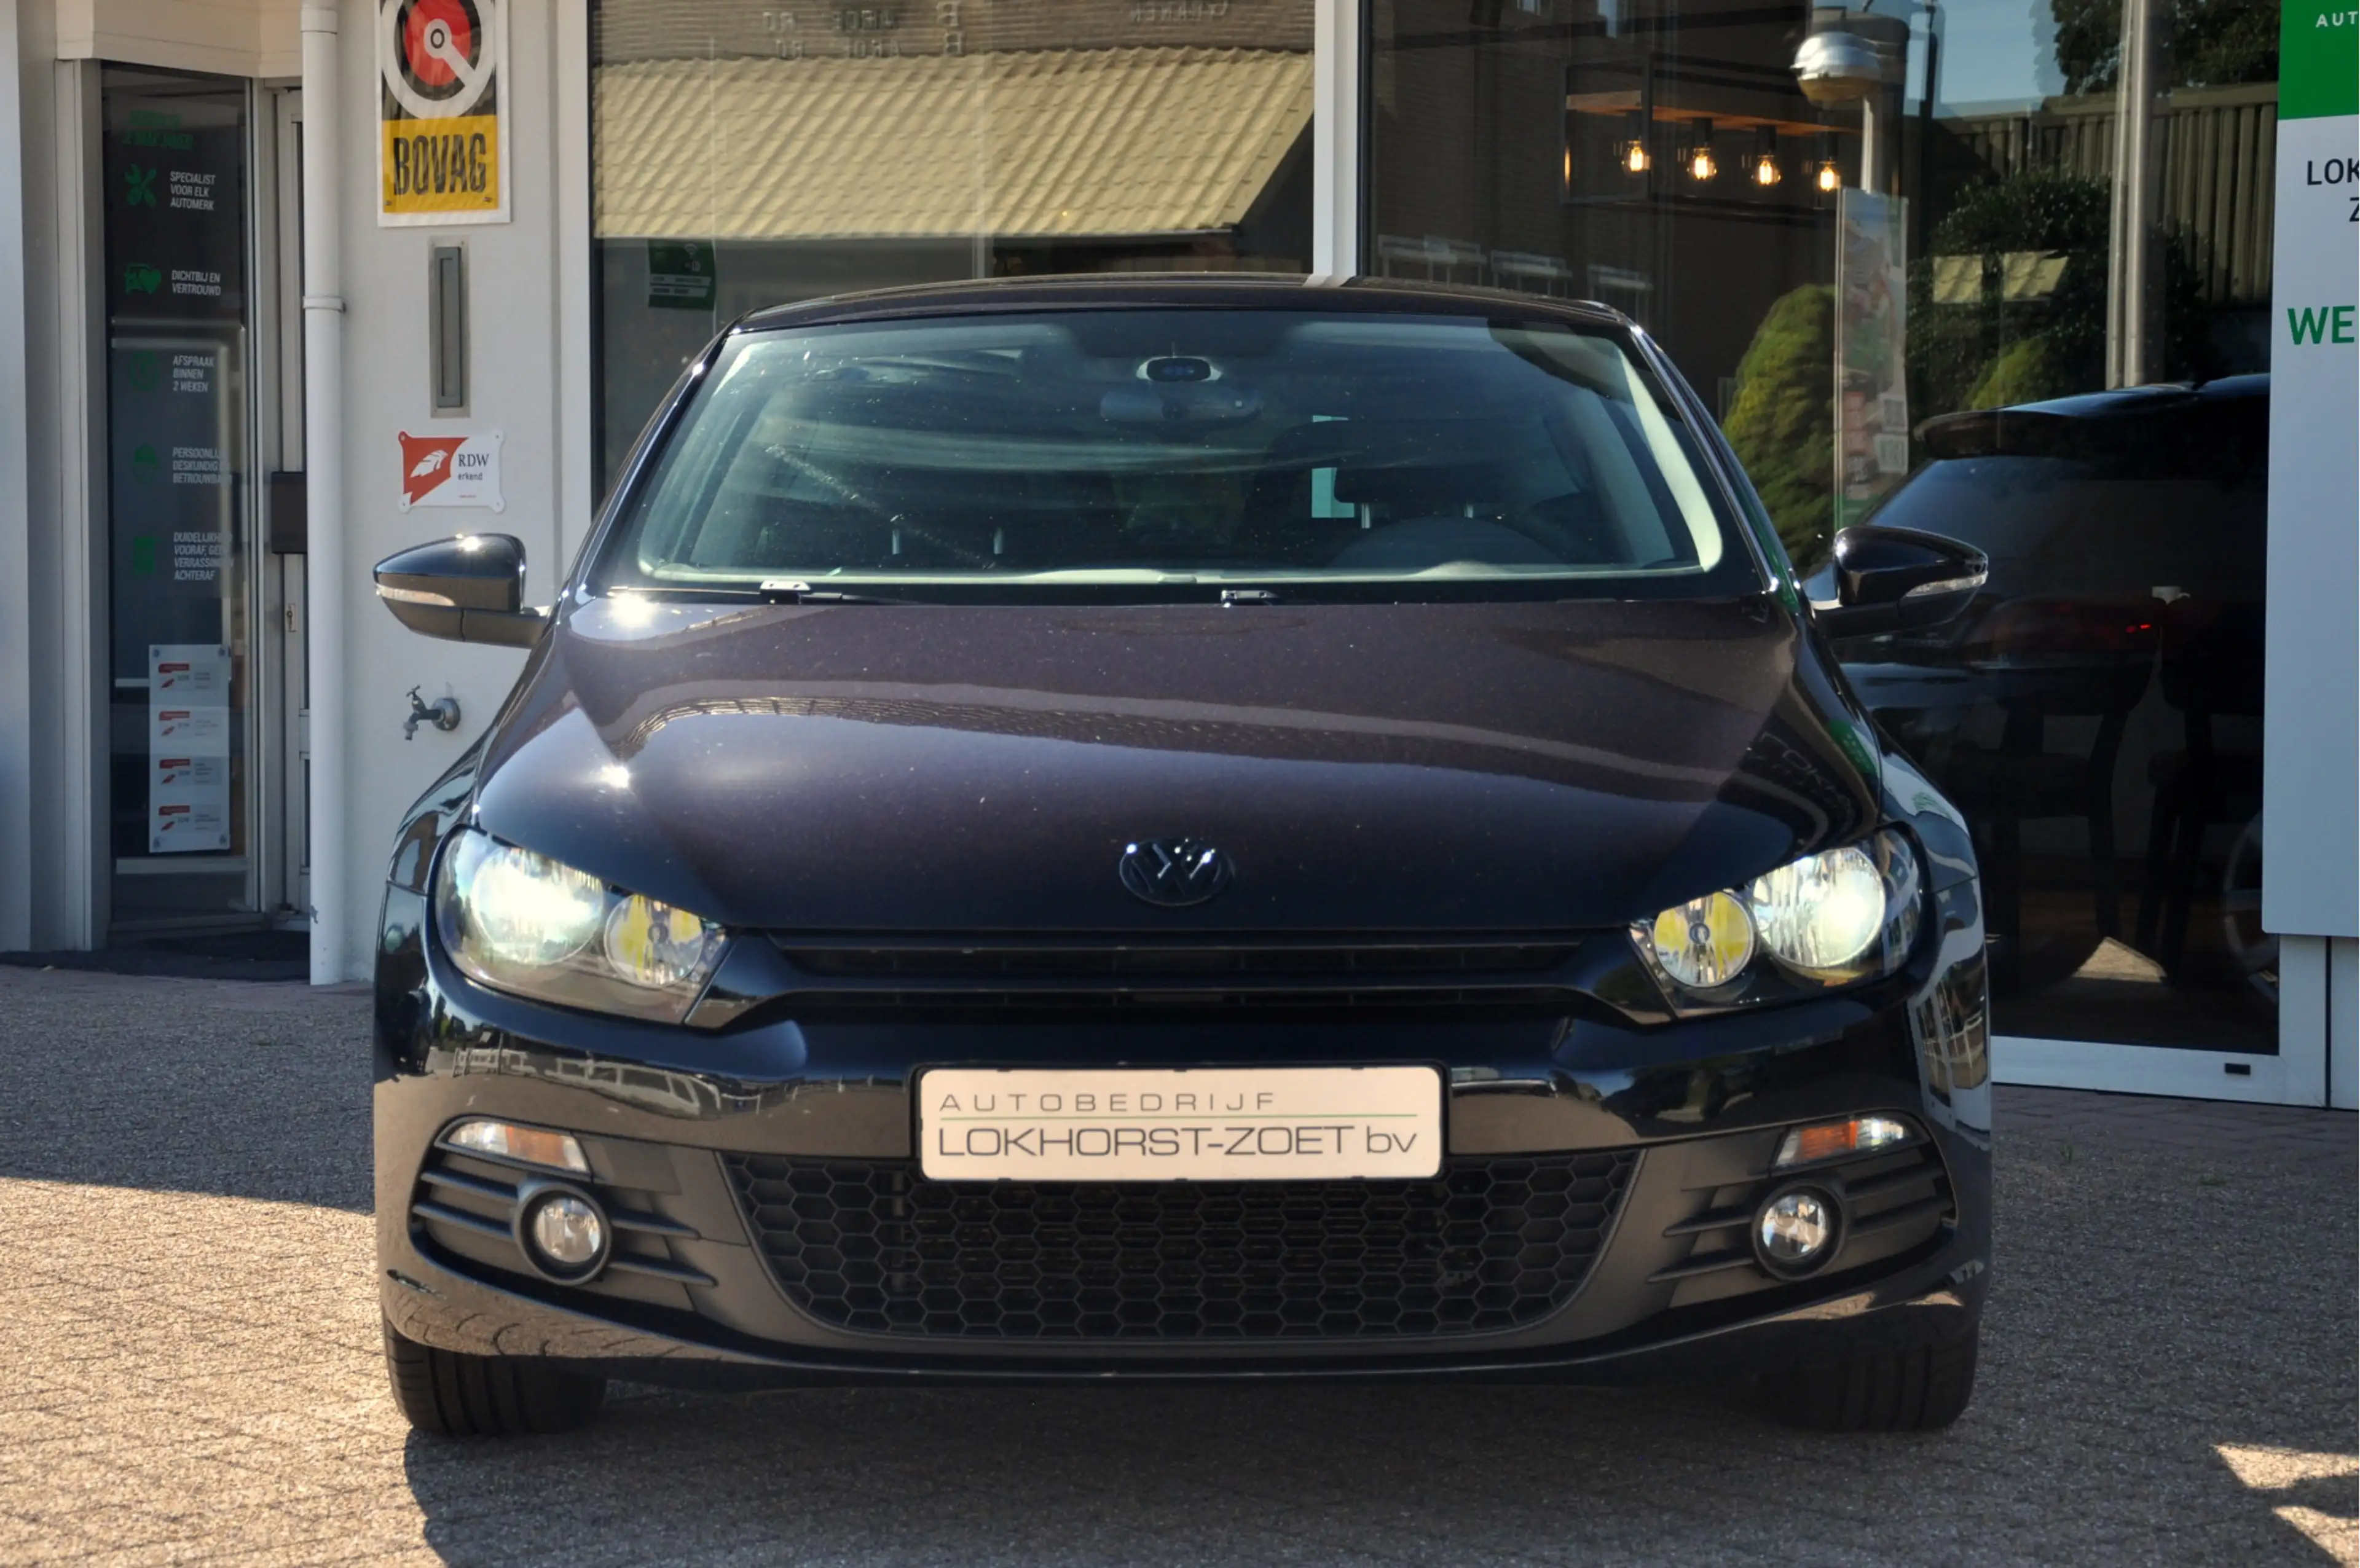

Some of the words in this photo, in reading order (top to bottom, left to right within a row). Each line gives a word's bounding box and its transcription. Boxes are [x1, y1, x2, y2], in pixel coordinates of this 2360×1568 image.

[2315, 11, 2359, 28] AUT
[393, 132, 487, 196] BOVAG
[170, 171, 216, 185] SPECIALIST
[2307, 158, 2359, 186] LOK
[170, 184, 193, 196] VOOR
[194, 186, 210, 197] ELK
[170, 197, 214, 211] AUTOMERK
[172, 270, 208, 282] DICHTBIJ
[209, 272, 221, 283] EN
[172, 283, 221, 296] VERTROUWD
[2287, 305, 2355, 345] WE
[173, 355, 215, 367] AFSPRAAK
[173, 368, 204, 379] BINNEN
[173, 381, 179, 391] 2
[180, 381, 209, 393] WEKEN
[458, 453, 490, 467] RDW
[458, 472, 483, 481] erkend
[174, 570, 215, 581] ACHTERAF
[940, 1092, 1276, 1113] AUTOBEDRIJF
[939, 1126, 1355, 1157] LOKHORST-ZOET
[1367, 1126, 1417, 1154] bv
